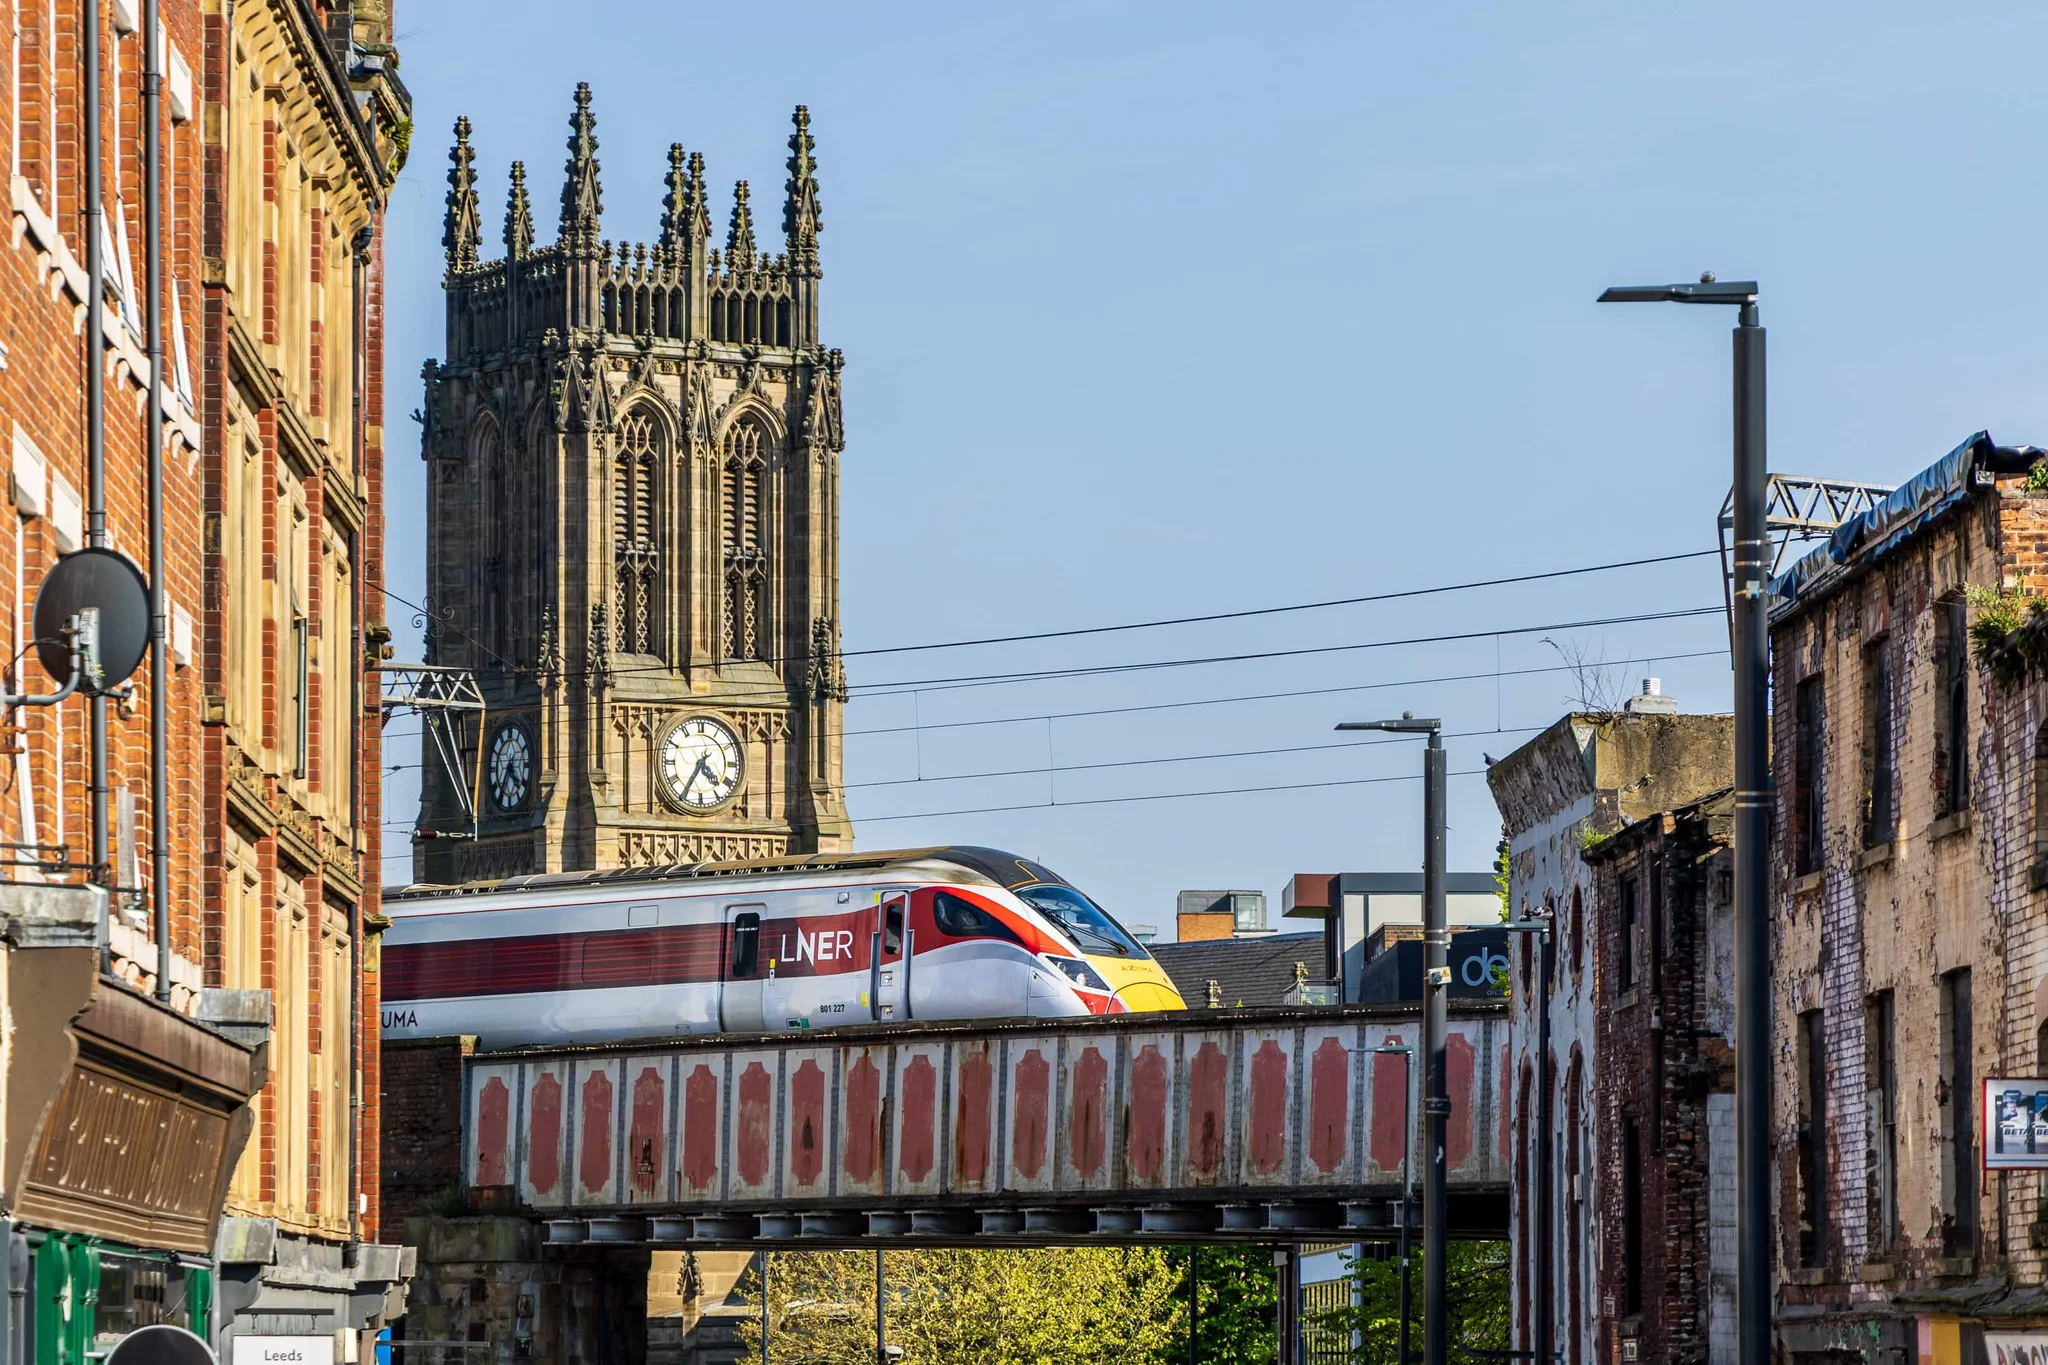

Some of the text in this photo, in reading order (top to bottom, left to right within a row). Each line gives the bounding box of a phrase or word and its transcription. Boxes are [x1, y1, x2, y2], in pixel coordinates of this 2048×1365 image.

[781, 926, 853, 967] LNER
[820, 1004, 845, 1013] 801 227
[380, 1010, 418, 1029] UMA
[264, 1349, 303, 1361] Leeds
